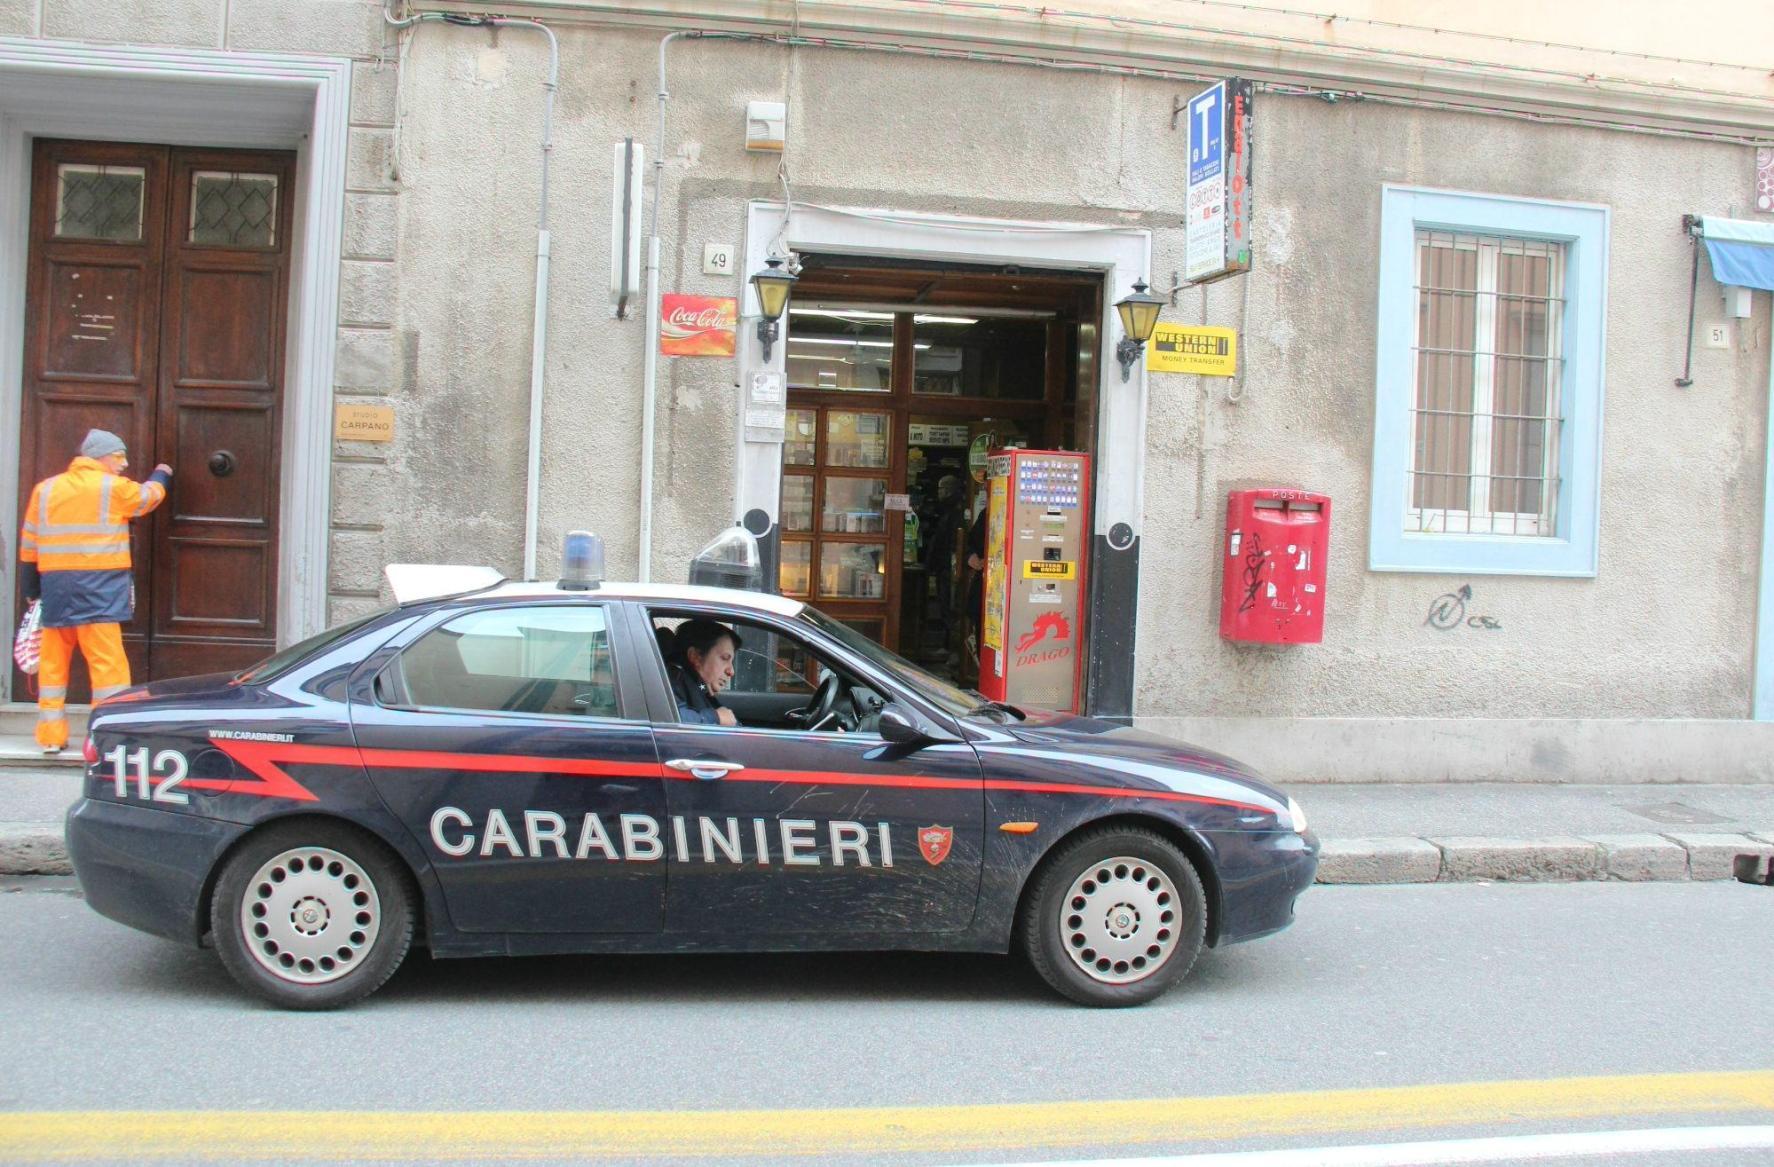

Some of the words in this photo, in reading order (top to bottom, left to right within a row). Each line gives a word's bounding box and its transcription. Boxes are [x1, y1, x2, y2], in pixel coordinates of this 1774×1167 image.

[1196, 94, 1216, 160] T
[711, 253, 726, 268] 49
[1157, 333, 1217, 346] WESTERN
[1713, 330, 1723, 342] 51
[1175, 342, 1217, 355] UNION
[1162, 355, 1187, 364] MONEY
[1190, 356, 1225, 367] TRANSFER
[341, 421, 390, 431] CARPANO
[1272, 491, 1310, 500] POSTE
[1016, 646, 1071, 667] DRAGO
[104, 744, 189, 804] 112
[430, 806, 894, 868] CARABINIERI
